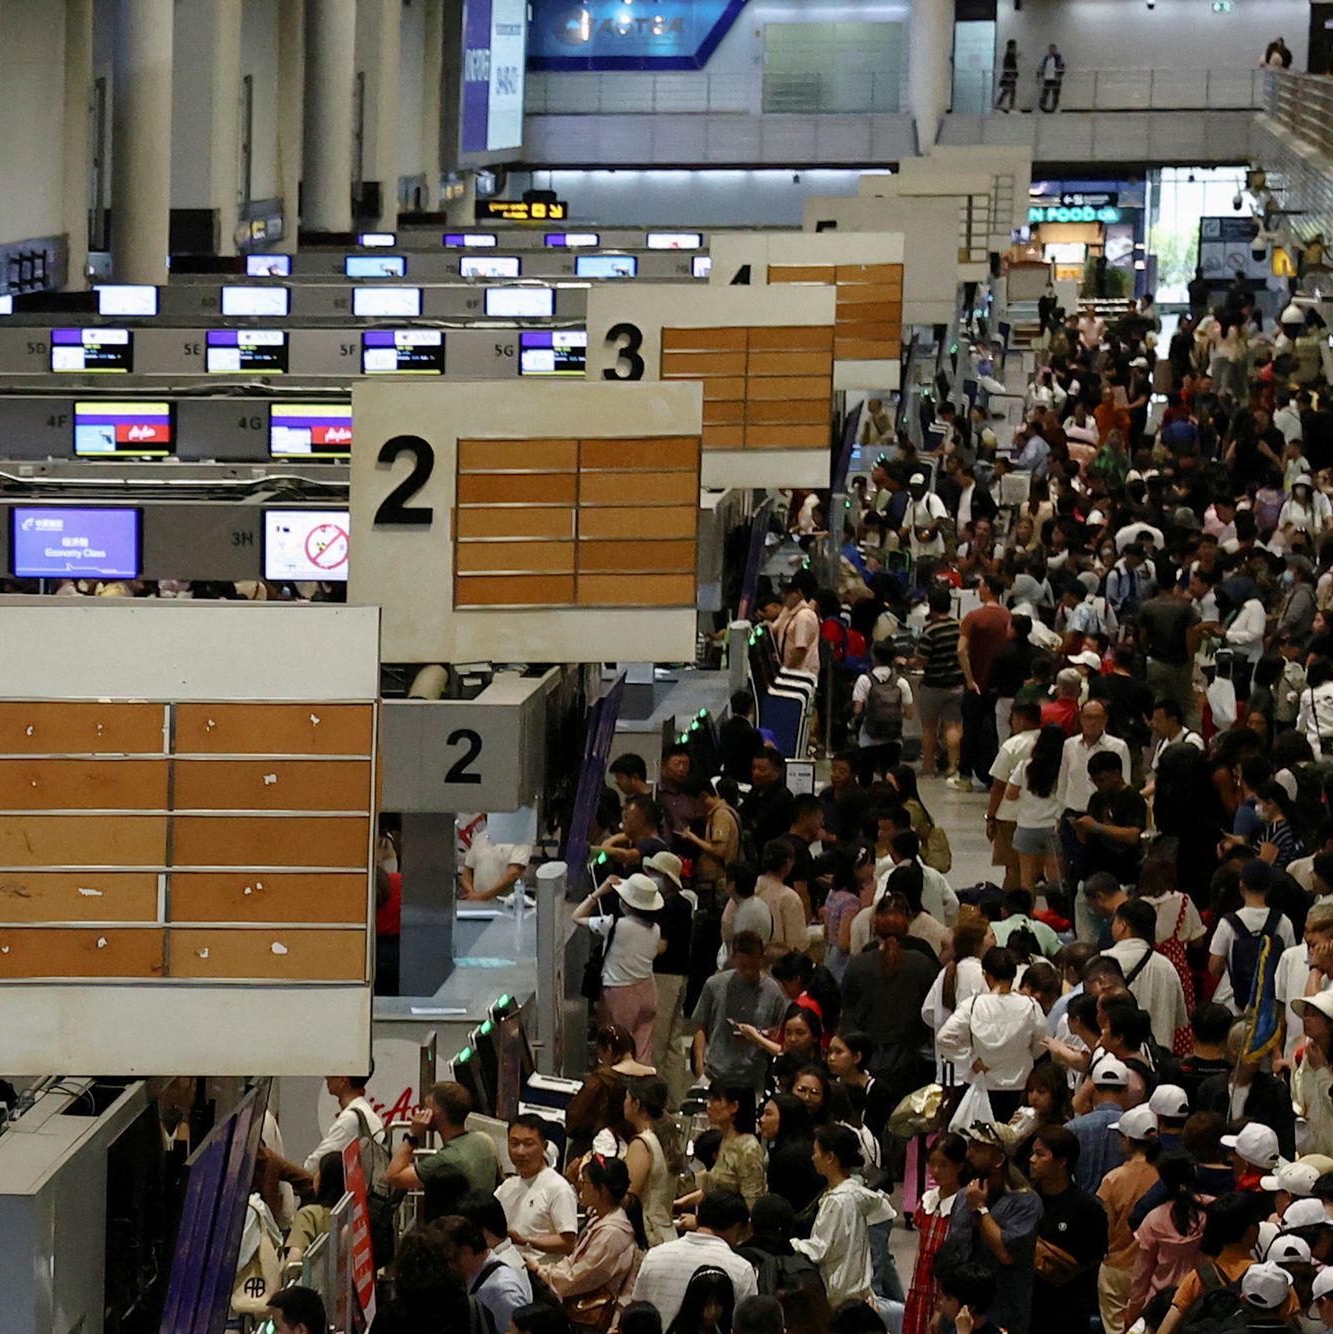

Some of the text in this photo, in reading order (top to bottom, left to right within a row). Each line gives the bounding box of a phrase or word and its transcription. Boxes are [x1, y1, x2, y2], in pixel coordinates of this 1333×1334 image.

[27, 342, 46, 355] 5D
[183, 343, 201, 356] 5E
[340, 344, 355, 356] 5F
[495, 344, 514, 357] 5G
[602, 322, 645, 381] 3
[47, 415, 67, 428] 4F
[238, 417, 263, 430] 4G
[373, 434, 435, 526] 2
[231, 530, 253, 547] 3H
[443, 729, 482, 785] 2
